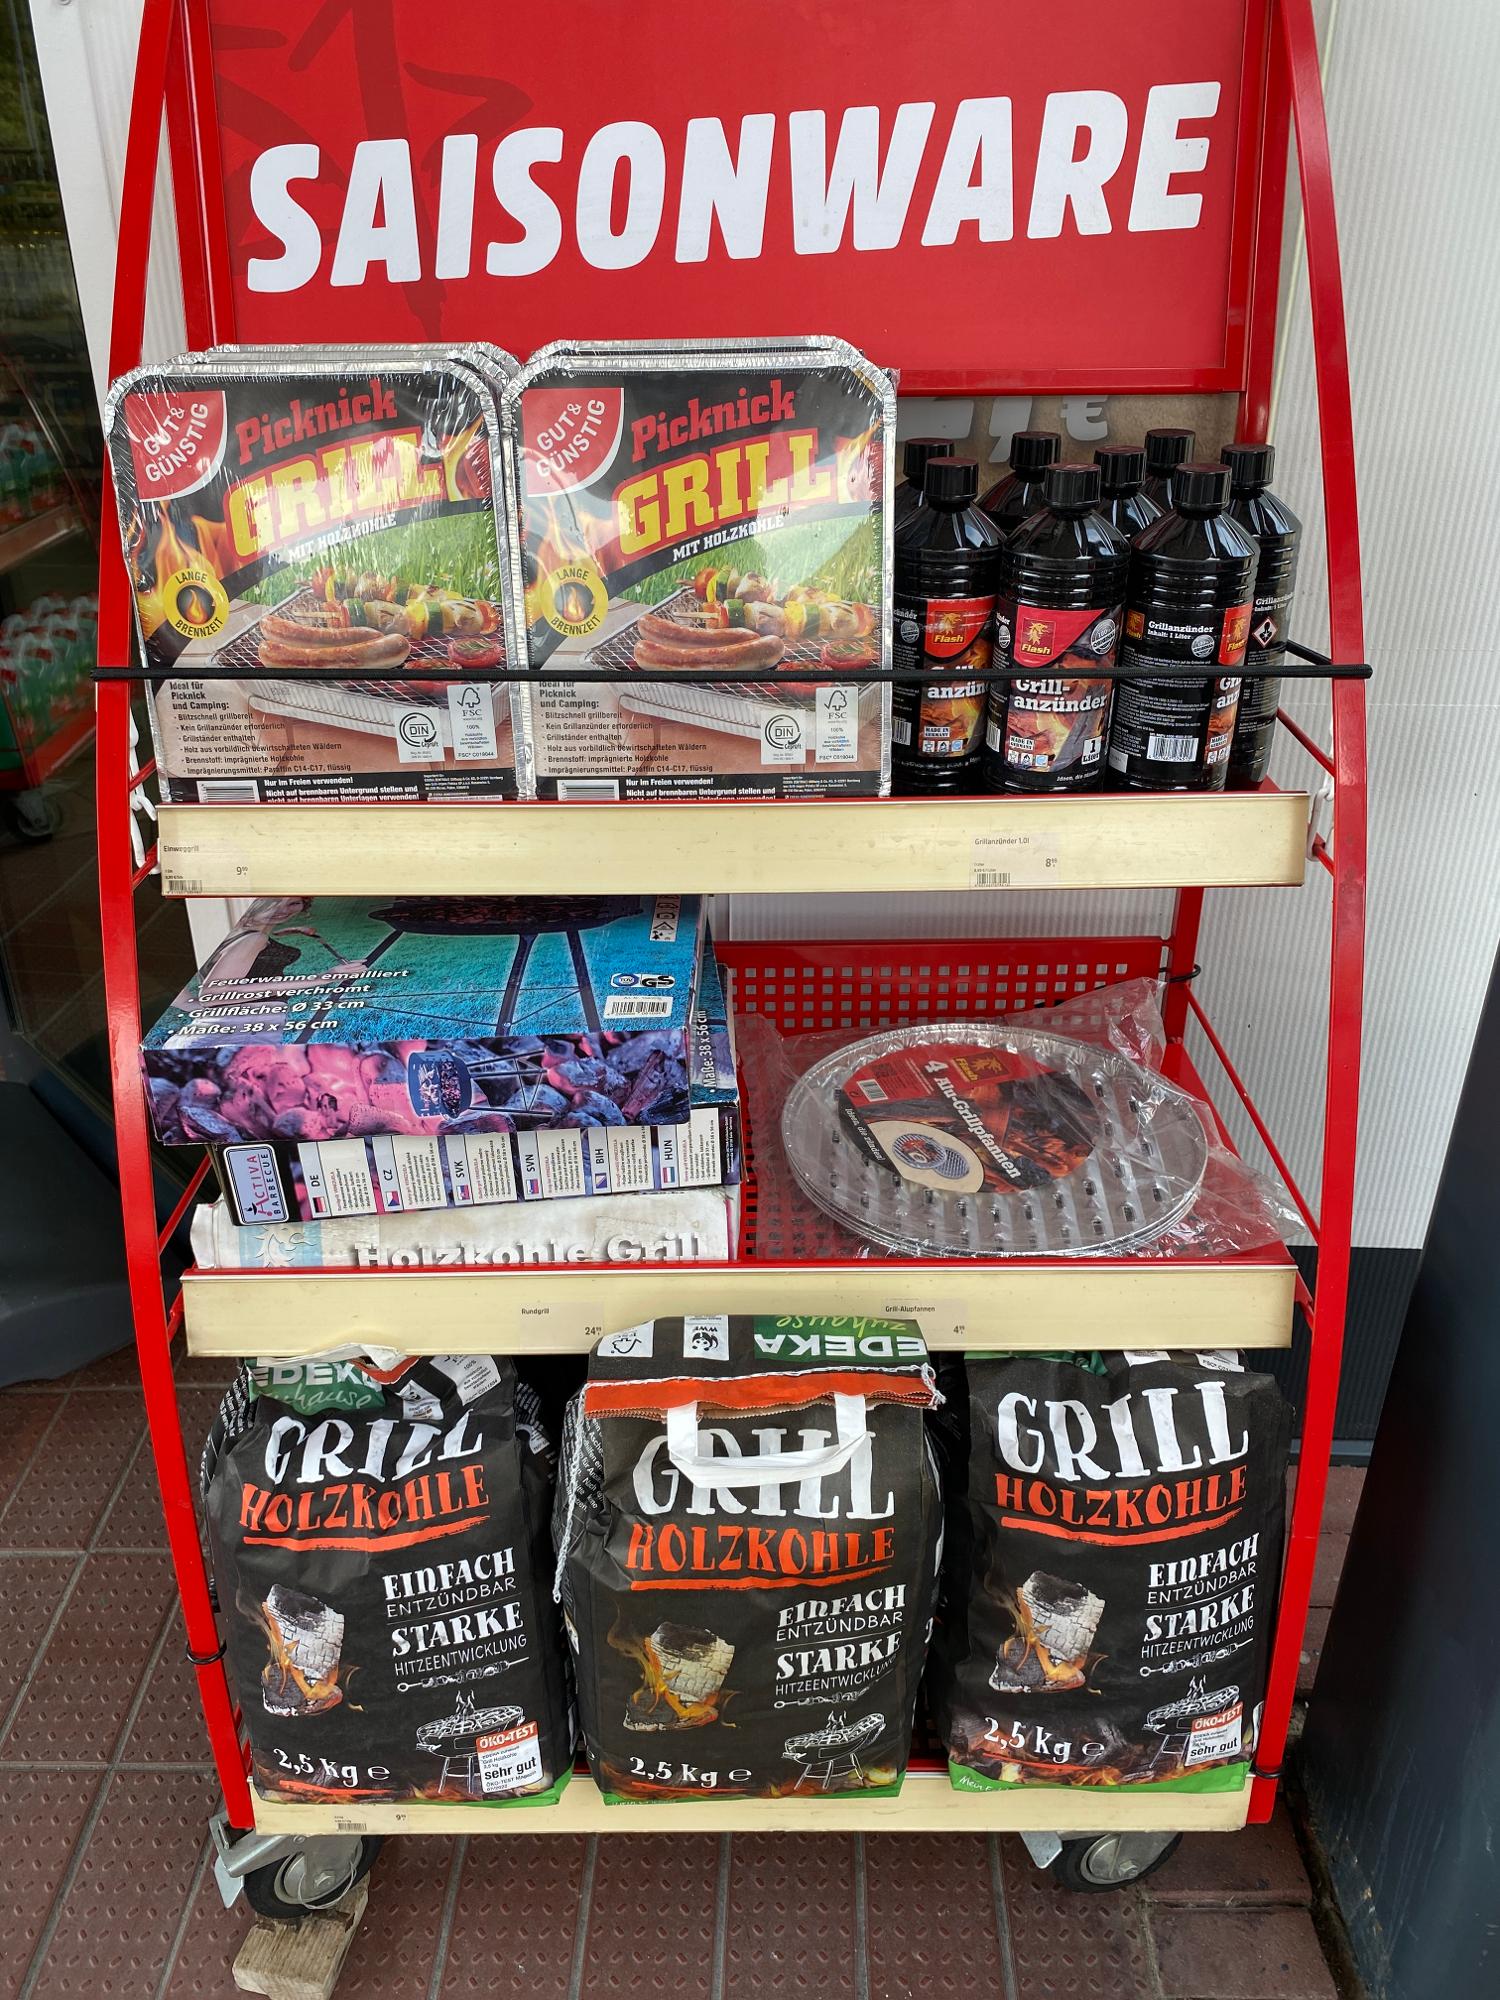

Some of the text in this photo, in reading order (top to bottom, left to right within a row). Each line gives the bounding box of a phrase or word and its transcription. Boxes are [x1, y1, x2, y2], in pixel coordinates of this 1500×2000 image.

[246, 81, 1221, 293] SAISONWARE
[235, 378, 397, 465] Picknick
[631, 379, 796, 463] Picknick
[145, 402, 209, 482] GÜNSTIG
[536, 398, 605, 478] GÜNSTIG
[227, 431, 441, 557] GRILL
[616, 433, 831, 555] GRILL
[673, 516, 784, 562] MIT HOLZKOHLE
[174, 571, 208, 585] LANGE
[556, 567, 589, 581] LANGE
[174, 616, 223, 637] BRENNZEIT
[551, 614, 601, 635] BRENNZEIT
[1149, 621, 1214, 633] Grillanzünder
[933, 634, 964, 644] Flash
[1147, 629, 1191, 640] Inhalt: Liter
[1021, 643, 1051, 655] Flash
[191, 681, 203, 690] für
[539, 689, 576, 698] Picknick
[1015, 678, 1070, 695] Grill-
[171, 691, 206, 700] Picknick
[540, 699, 599, 709] und Camping:
[1014, 690, 1107, 713] anzünder
[172, 701, 229, 711] und Camping:
[462, 709, 482, 717] FSC
[178, 712, 253, 722] Blitzschnell grillbereit
[545, 711, 622, 720] Blitzschnell grillbereit
[180, 722, 285, 731] Kein Grillanzünder erforderlich
[409, 725, 429, 736] DIN
[546, 722, 653, 730] Kein Grillanzünder erforderlich
[775, 727, 794, 737] DIN
[182, 734, 256, 742] Grillständer enthalten
[547, 733, 622, 741] Grillständer enthalten
[213, 745, 250, 753] vorbildlich
[251, 743, 311, 752] bewirtschafteten
[547, 744, 562, 752] Holz
[579, 744, 616, 752] vorbildlich
[618, 743, 677, 751] bewirtschafteten
[678, 743, 707, 751] Wäldern
[1089, 740, 1096, 753] 1
[185, 754, 305, 764] Brennstoff: imprägnierte Holzkohle
[548, 754, 668, 764] Brennstoff: imprägnierte Holzkohle
[187, 763, 351, 776] Imprägnierungsmittel: Paraffin C14-C17, flüssig
[548, 764, 713, 774] Imprägnierungsmittel: Paraffin C14-C17, flüssig
[264, 779, 277, 787] Nur
[289, 778, 311, 786] Freien
[312, 777, 353, 785] verwenden!
[650, 778, 672, 786] Freien
[674, 778, 714, 786] verwenden!
[266, 789, 285, 797] Nicht
[298, 788, 339, 796] brennbaren
[340, 787, 378, 795] Untergrund
[380, 785, 404, 793] stellen
[404, 785, 418, 793] und
[626, 787, 775, 797] Nicht auf brennbaren Untergrund stellen und
[974, 837, 1017, 845] Grillanzünder
[208, 969, 409, 988] Feuerwanne emailliert
[642, 975, 674, 988] GS
[198, 983, 371, 1003] Grillrost verchromt
[188, 1000, 364, 1020] Grillfläche: 33 cm
[697, 1010, 707, 1023] cm
[178, 1020, 337, 1037] Maße: 38 x 56 cm
[697, 1025, 710, 1036] 56
[699, 1045, 712, 1057] 38
[700, 1057, 717, 1088] Maße:
[924, 1059, 948, 1074] 4
[956, 1058, 979, 1081] Flash
[934, 1077, 1022, 1179] Alu-Grillpfannen
[595, 1148, 605, 1164] BIH
[663, 1139, 673, 1161] HUN
[454, 1160, 465, 1178] SVK
[526, 1154, 536, 1173] SVN
[310, 1174, 320, 1187] DE
[383, 1169, 393, 1181] CZ
[246, 1154, 271, 1215] ACTIVA
[261, 1153, 281, 1215] BARBECUE
[355, 1232, 701, 1267] Holzkohle Grill
[521, 1308, 549, 1316] Rundgrill
[885, 1305, 935, 1313] Grill-Alupfannen
[776, 1315, 907, 1338] zuhause
[754, 1333, 928, 1357] EDEKA
[997, 1381, 1248, 1481] GRILL
[265, 1408, 483, 1484] GRILL
[632, 1428, 895, 1520] GRILL
[239, 1464, 490, 1533] HOLZKOHLE
[995, 1465, 1248, 1528] HOLZKOHLE
[625, 1524, 895, 1574] HOLZKOHLE
[1147, 1561, 1256, 1604] ENTZÜNDBAR
[387, 1577, 516, 1618] ENTZÜNDBAR
[1143, 1584, 1255, 1642] STARKE
[391, 1601, 524, 1657] STARKE
[776, 1611, 903, 1641] ENTZÜNDBAR
[1141, 1616, 1254, 1658] HITZEENTWICKLUNG
[395, 1634, 527, 1676] HITZEENTWICKLUNG
[776, 1631, 902, 1680] STARKE
[983, 1717, 1072, 1764] 2,5 kg
[1190, 1745, 1216, 1757] sehr
[1219, 1737, 1237, 1752] gut
[273, 1748, 358, 1788] 2,5 kg
[484, 1756, 537, 1780] sehr gut
[630, 1757, 718, 1788] 2,5 kg
